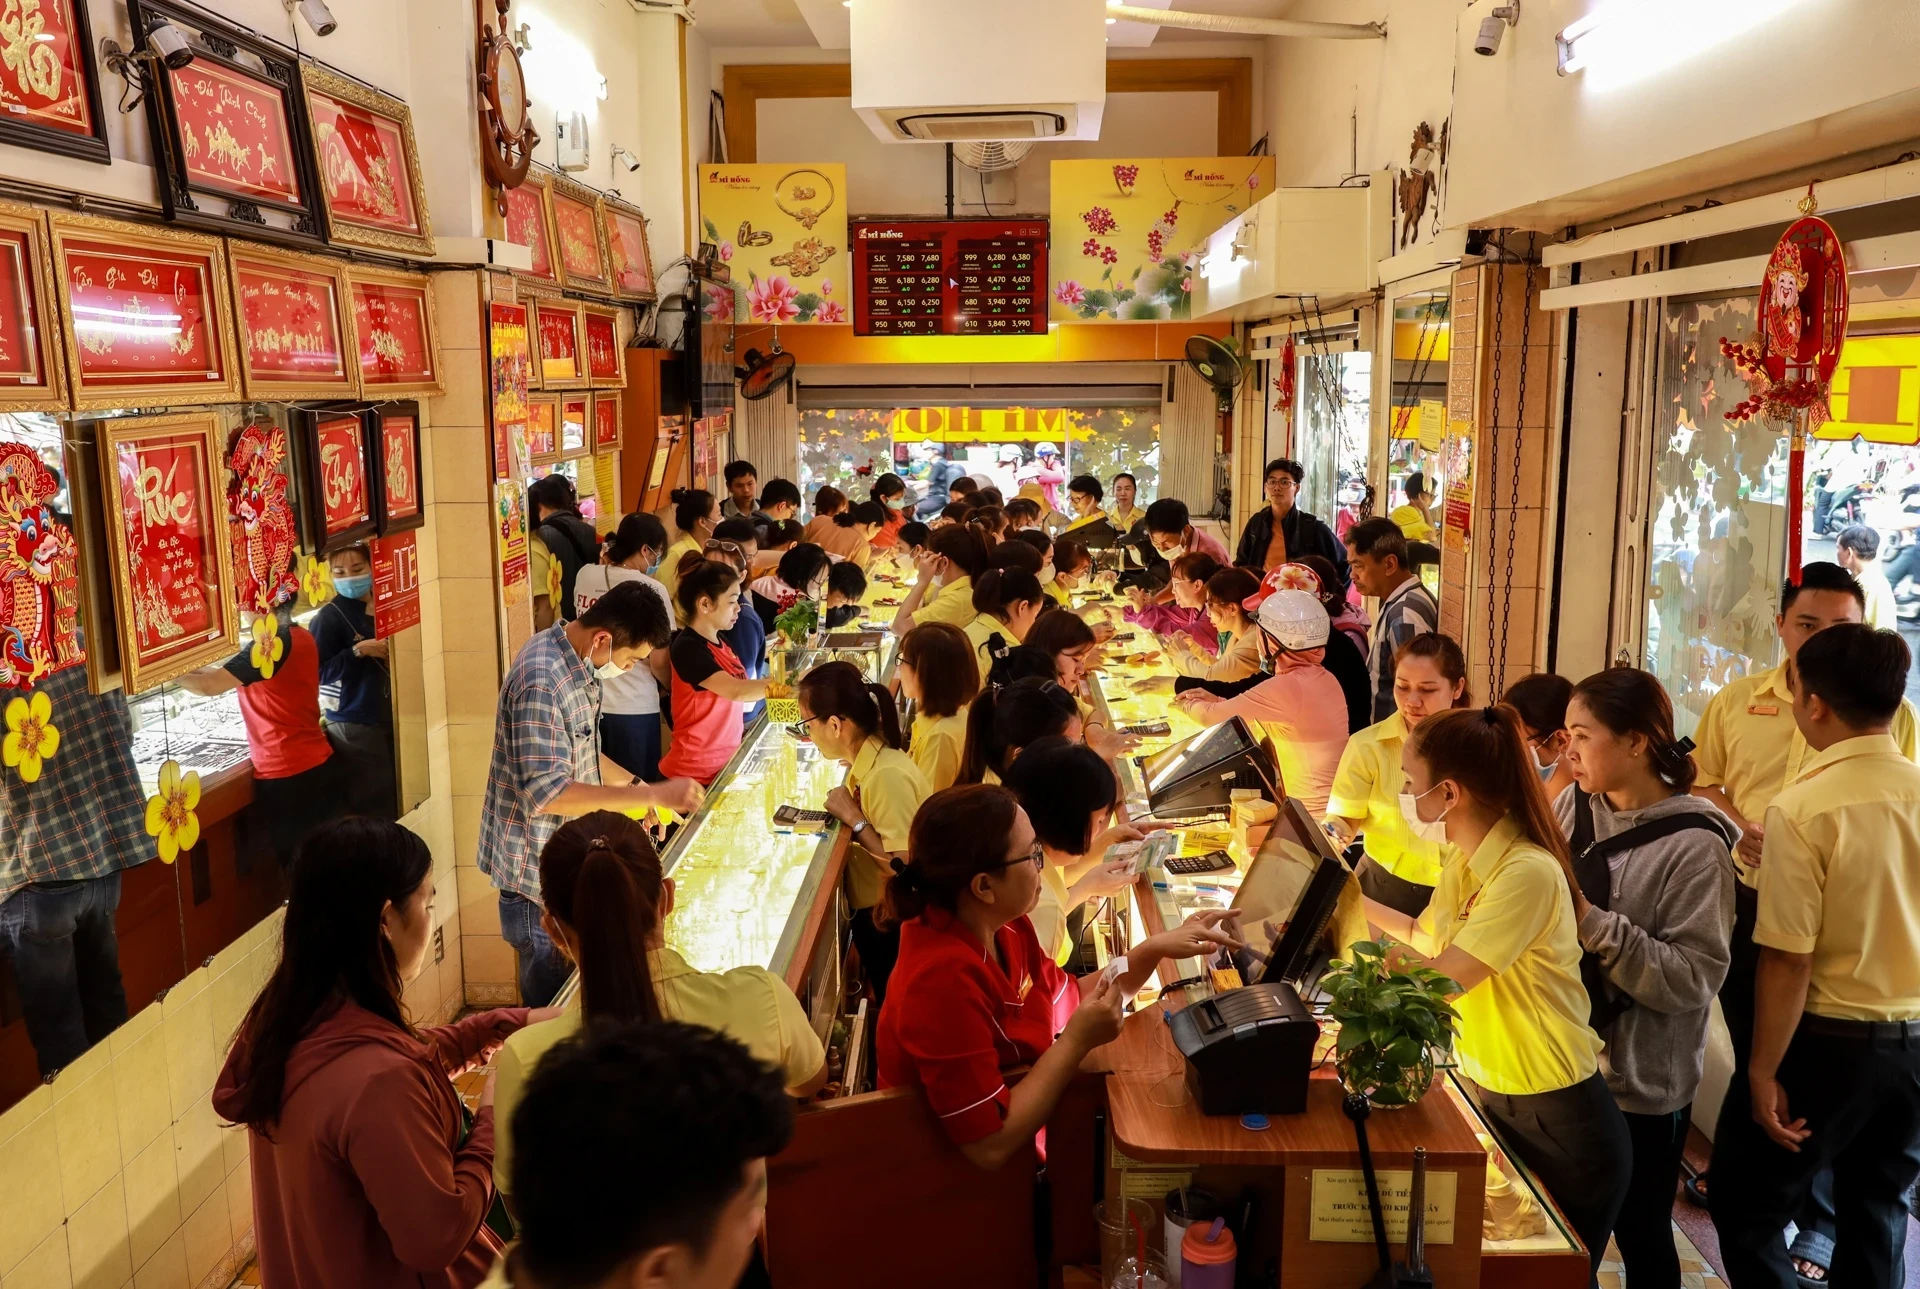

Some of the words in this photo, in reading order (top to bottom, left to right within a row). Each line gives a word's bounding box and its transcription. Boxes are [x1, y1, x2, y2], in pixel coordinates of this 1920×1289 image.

[73, 266, 92, 293] Tân
[987, 276, 1006, 284] 4,470
[1012, 276, 1030, 284] 4,620
[134, 455, 195, 546] Phúc
[52, 553, 75, 582] Chúc
[56, 613, 76, 637] Năm
